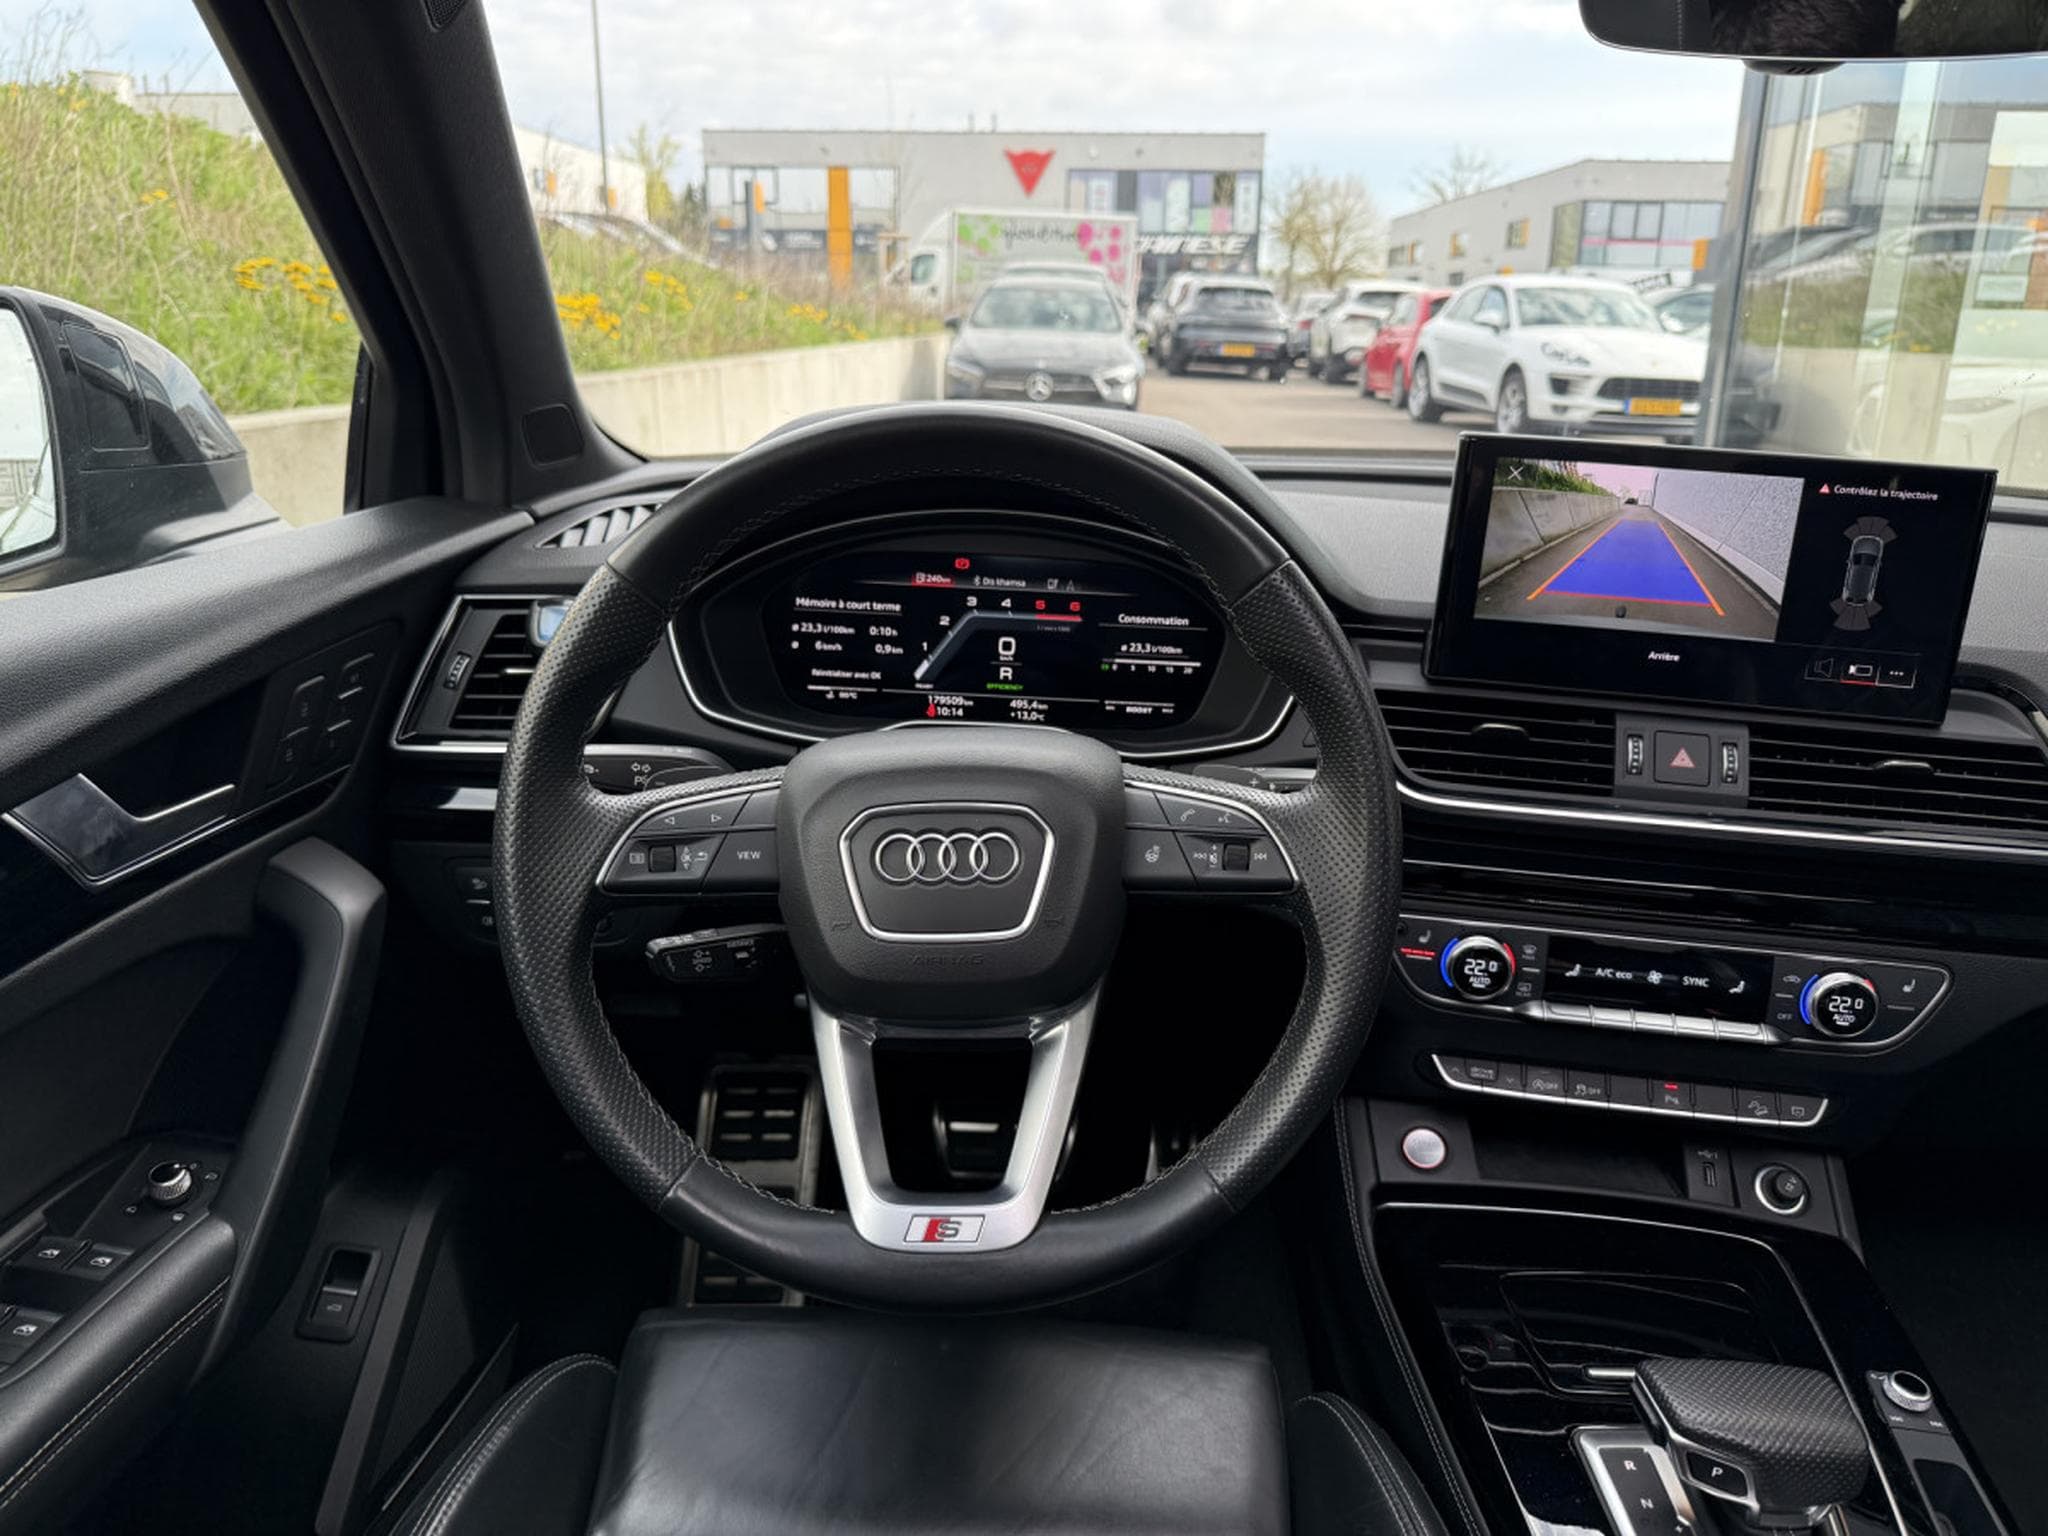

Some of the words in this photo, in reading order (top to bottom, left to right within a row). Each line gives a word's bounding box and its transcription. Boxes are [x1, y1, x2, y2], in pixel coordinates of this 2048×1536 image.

[1834, 484, 1878, 496] Contrôlez
[1880, 488, 1889, 497] la
[1890, 489, 1938, 500] trajectoire
[796, 596, 837, 608] Mémoire
[839, 598, 844, 608] à
[846, 601, 871, 610] court
[873, 602, 901, 611] terme
[966, 597, 977, 606] 3
[1001, 598, 1011, 607] 4
[1035, 600, 1045, 610] 5
[1070, 602, 1080, 611] 6
[939, 616, 950, 625] 2
[1118, 613, 1189, 626] Consommation
[922, 642, 928, 651] 1
[998, 636, 1016, 656] 0
[1648, 651, 1680, 662] Arrière
[999, 666, 1013, 680] R
[937, 707, 964, 716] 10:14
[736, 850, 761, 859] VIEW
[1595, 967, 1614, 978] A/C
[1616, 971, 1632, 980] eco
[1469, 976, 1491, 985] AUTO
[1682, 975, 1710, 988] SYNC
[1833, 1013, 1855, 1023] AUTO
[1624, 1460, 1637, 1471] R
[1711, 1466, 1723, 1478] P
[1640, 1498, 1654, 1509] N
